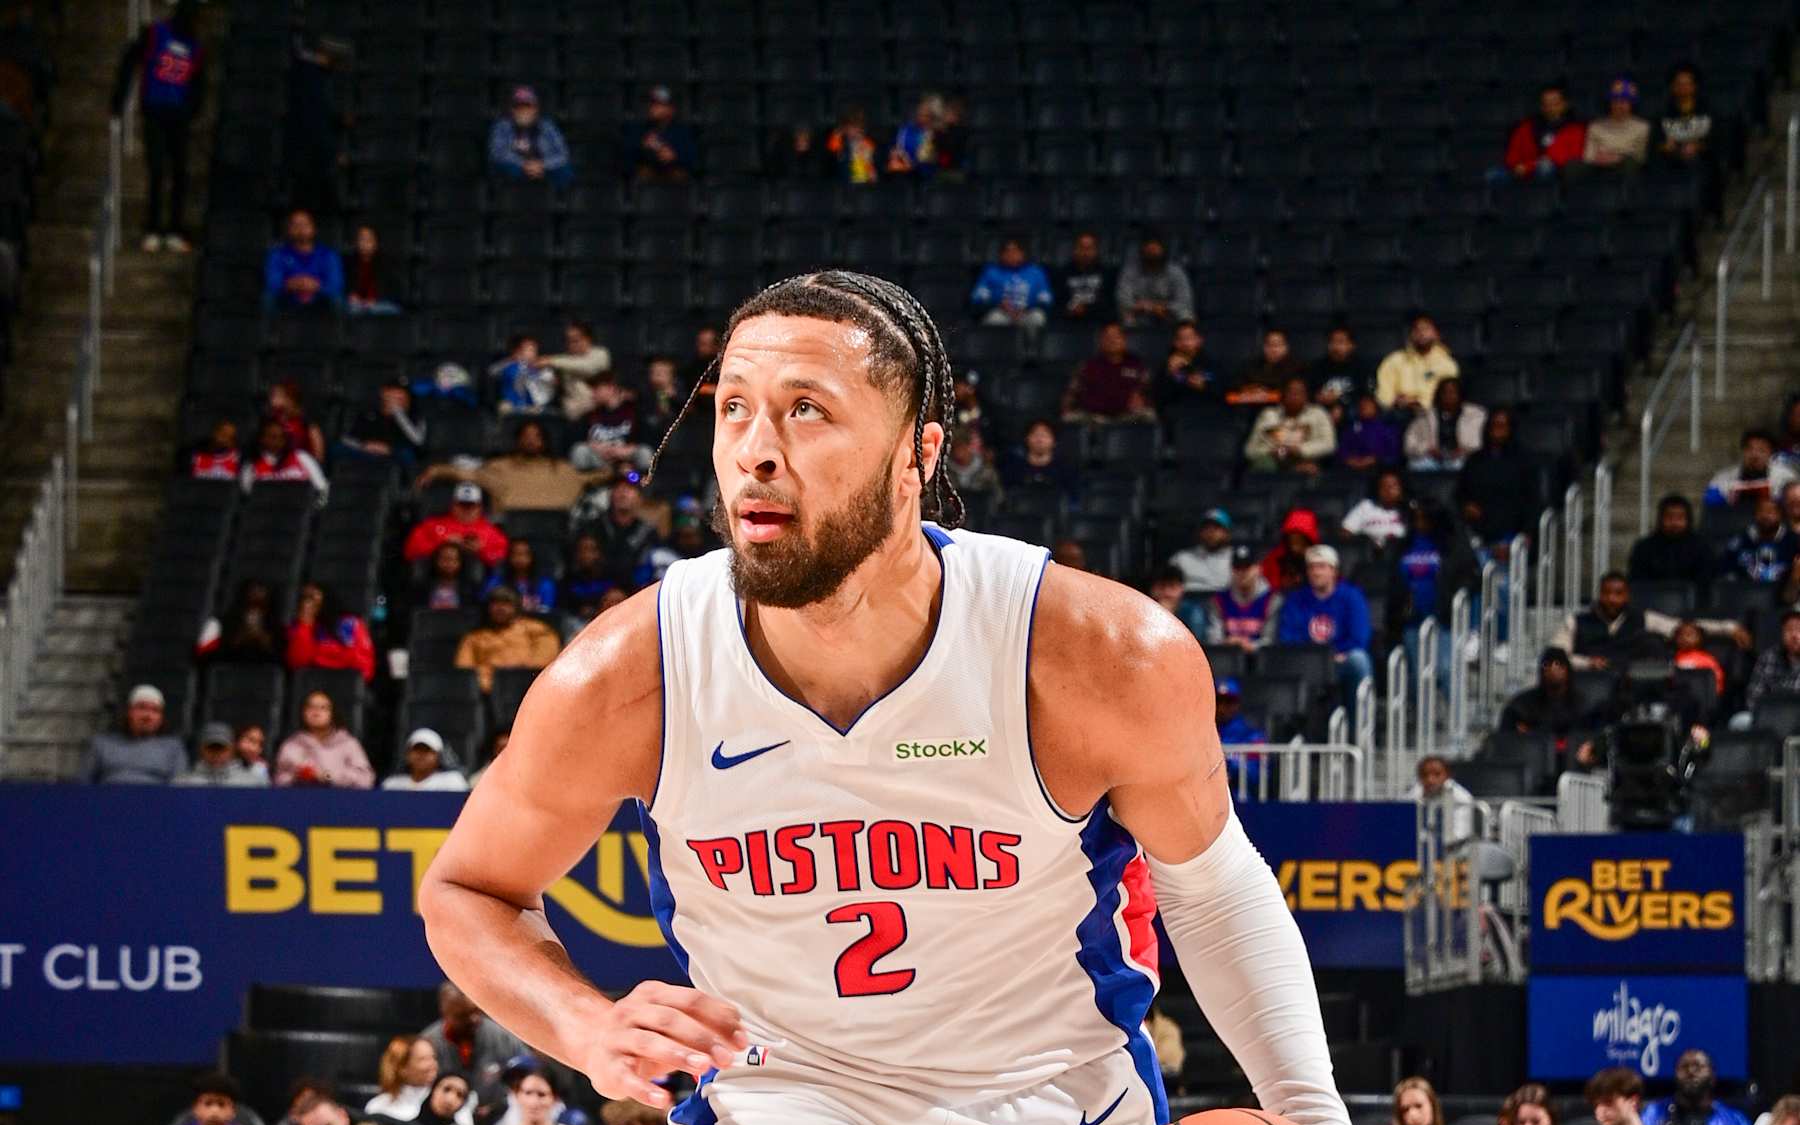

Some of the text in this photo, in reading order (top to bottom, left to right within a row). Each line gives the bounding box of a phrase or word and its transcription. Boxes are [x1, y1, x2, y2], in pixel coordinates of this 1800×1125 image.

[896, 739, 987, 760] StockX
[686, 820, 1022, 896] PISTONS
[1591, 859, 1671, 890] BET
[1544, 877, 1734, 941] RIVERS
[43, 943, 203, 991] CLUB
[825, 900, 916, 998] 2
